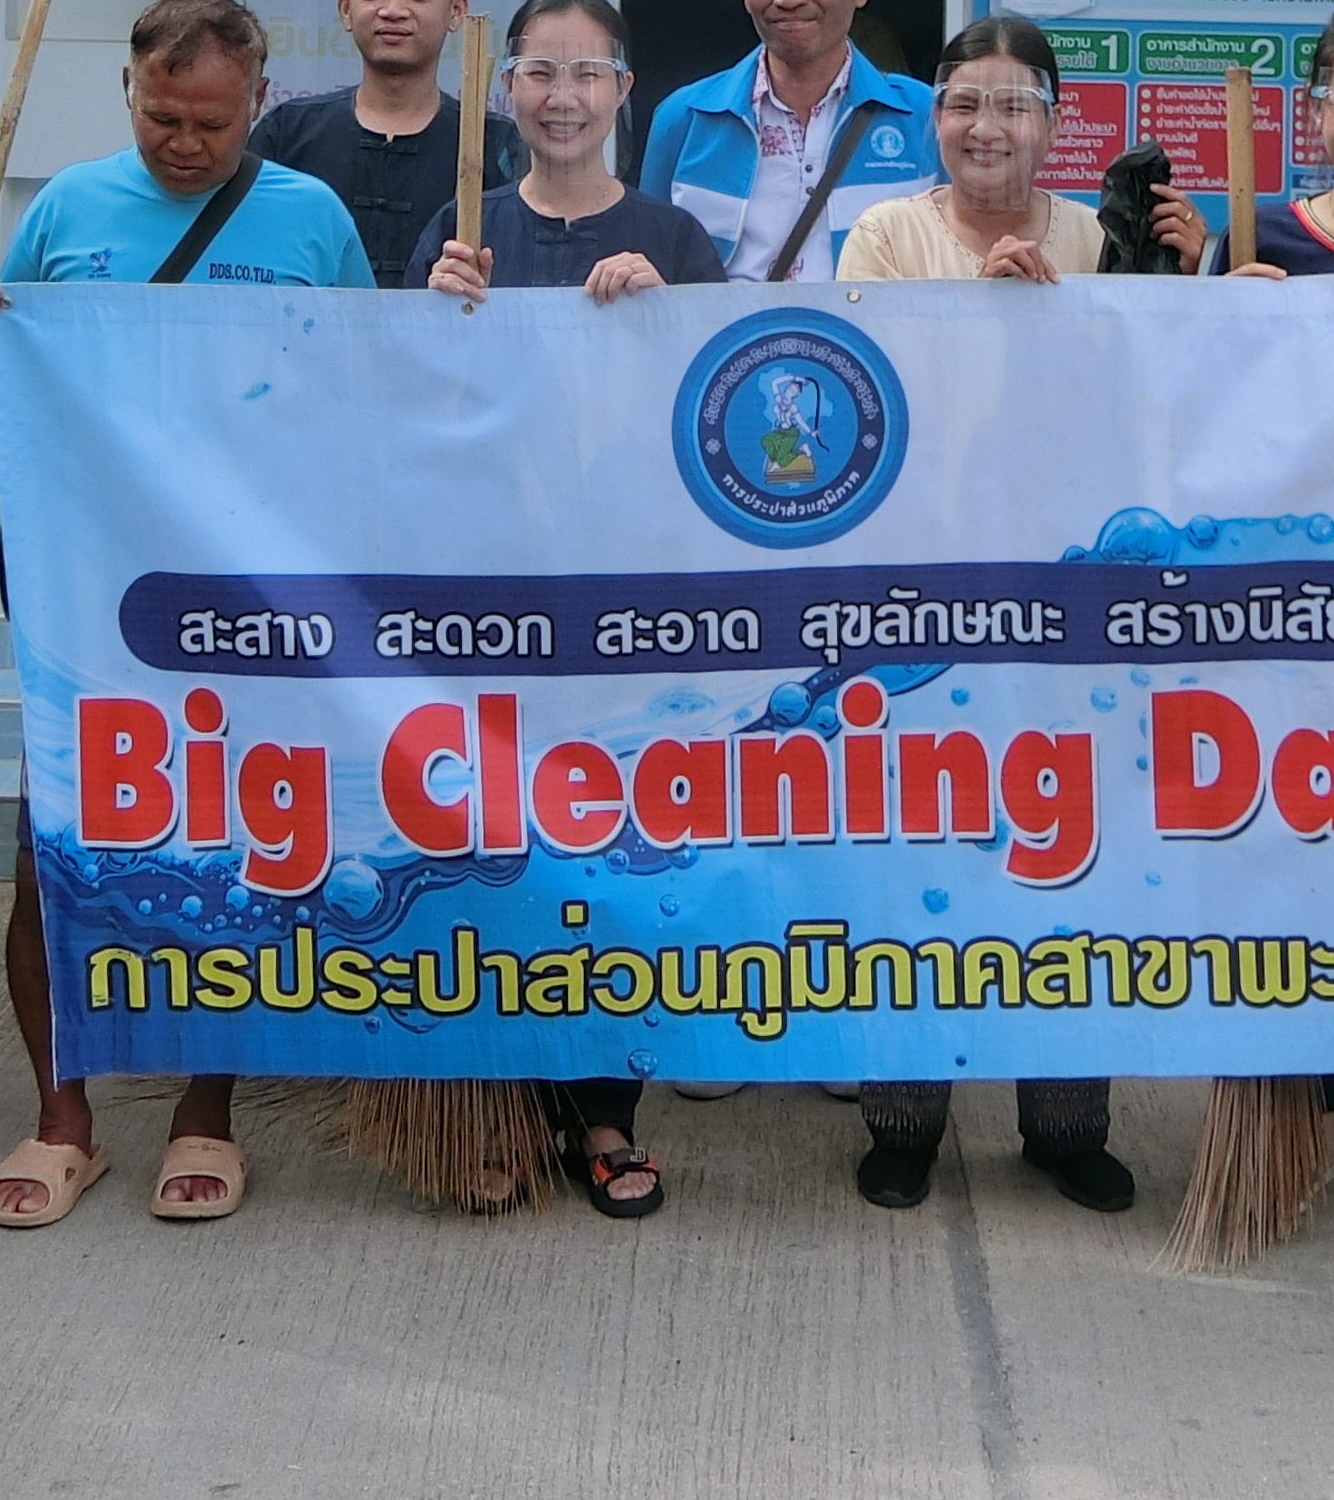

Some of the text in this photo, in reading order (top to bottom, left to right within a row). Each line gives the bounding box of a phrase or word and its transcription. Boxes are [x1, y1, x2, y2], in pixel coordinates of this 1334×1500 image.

[1100, 34, 1117, 70] 1
[1146, 36, 1245, 54] อาคารสำนักงาน
[1251, 38, 1276, 75] 2
[178, 608, 334, 660] สะสาง
[376, 608, 555, 659] สะดวก
[595, 602, 762, 656] สะอาด
[798, 586, 1065, 666] สุขลักษณะ
[75, 686, 335, 896] Big
[381, 680, 1100, 888] Cleaning
